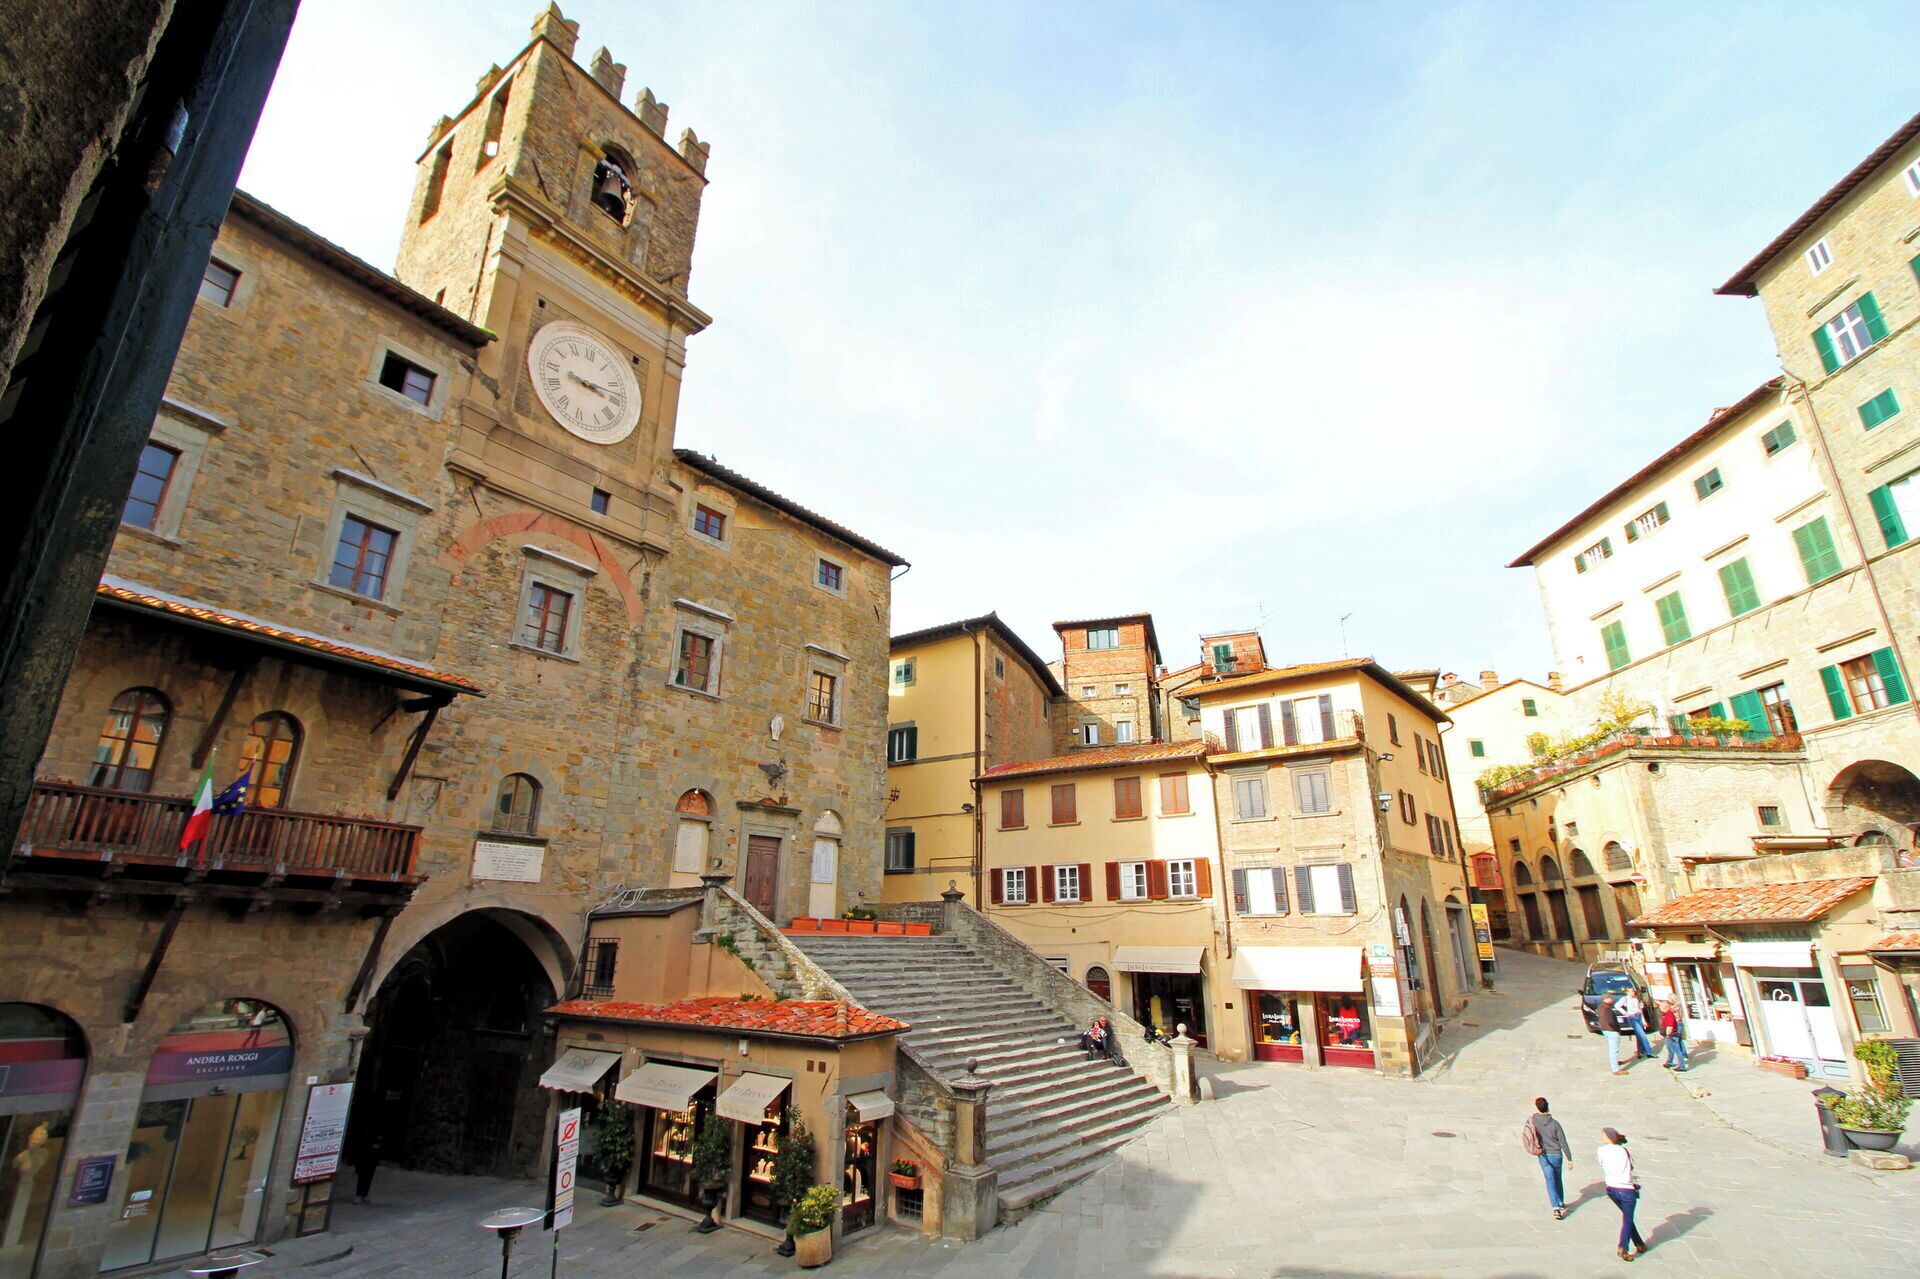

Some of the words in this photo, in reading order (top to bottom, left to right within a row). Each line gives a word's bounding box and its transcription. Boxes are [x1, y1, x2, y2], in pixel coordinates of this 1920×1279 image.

[584, 347, 596, 362] XII
[186, 1056, 226, 1065] ANDREA
[228, 1053, 258, 1062] ROGGI
[197, 1065, 246, 1074] EXCLUSIVE
[306, 1143, 339, 1154] PRELUDIO
